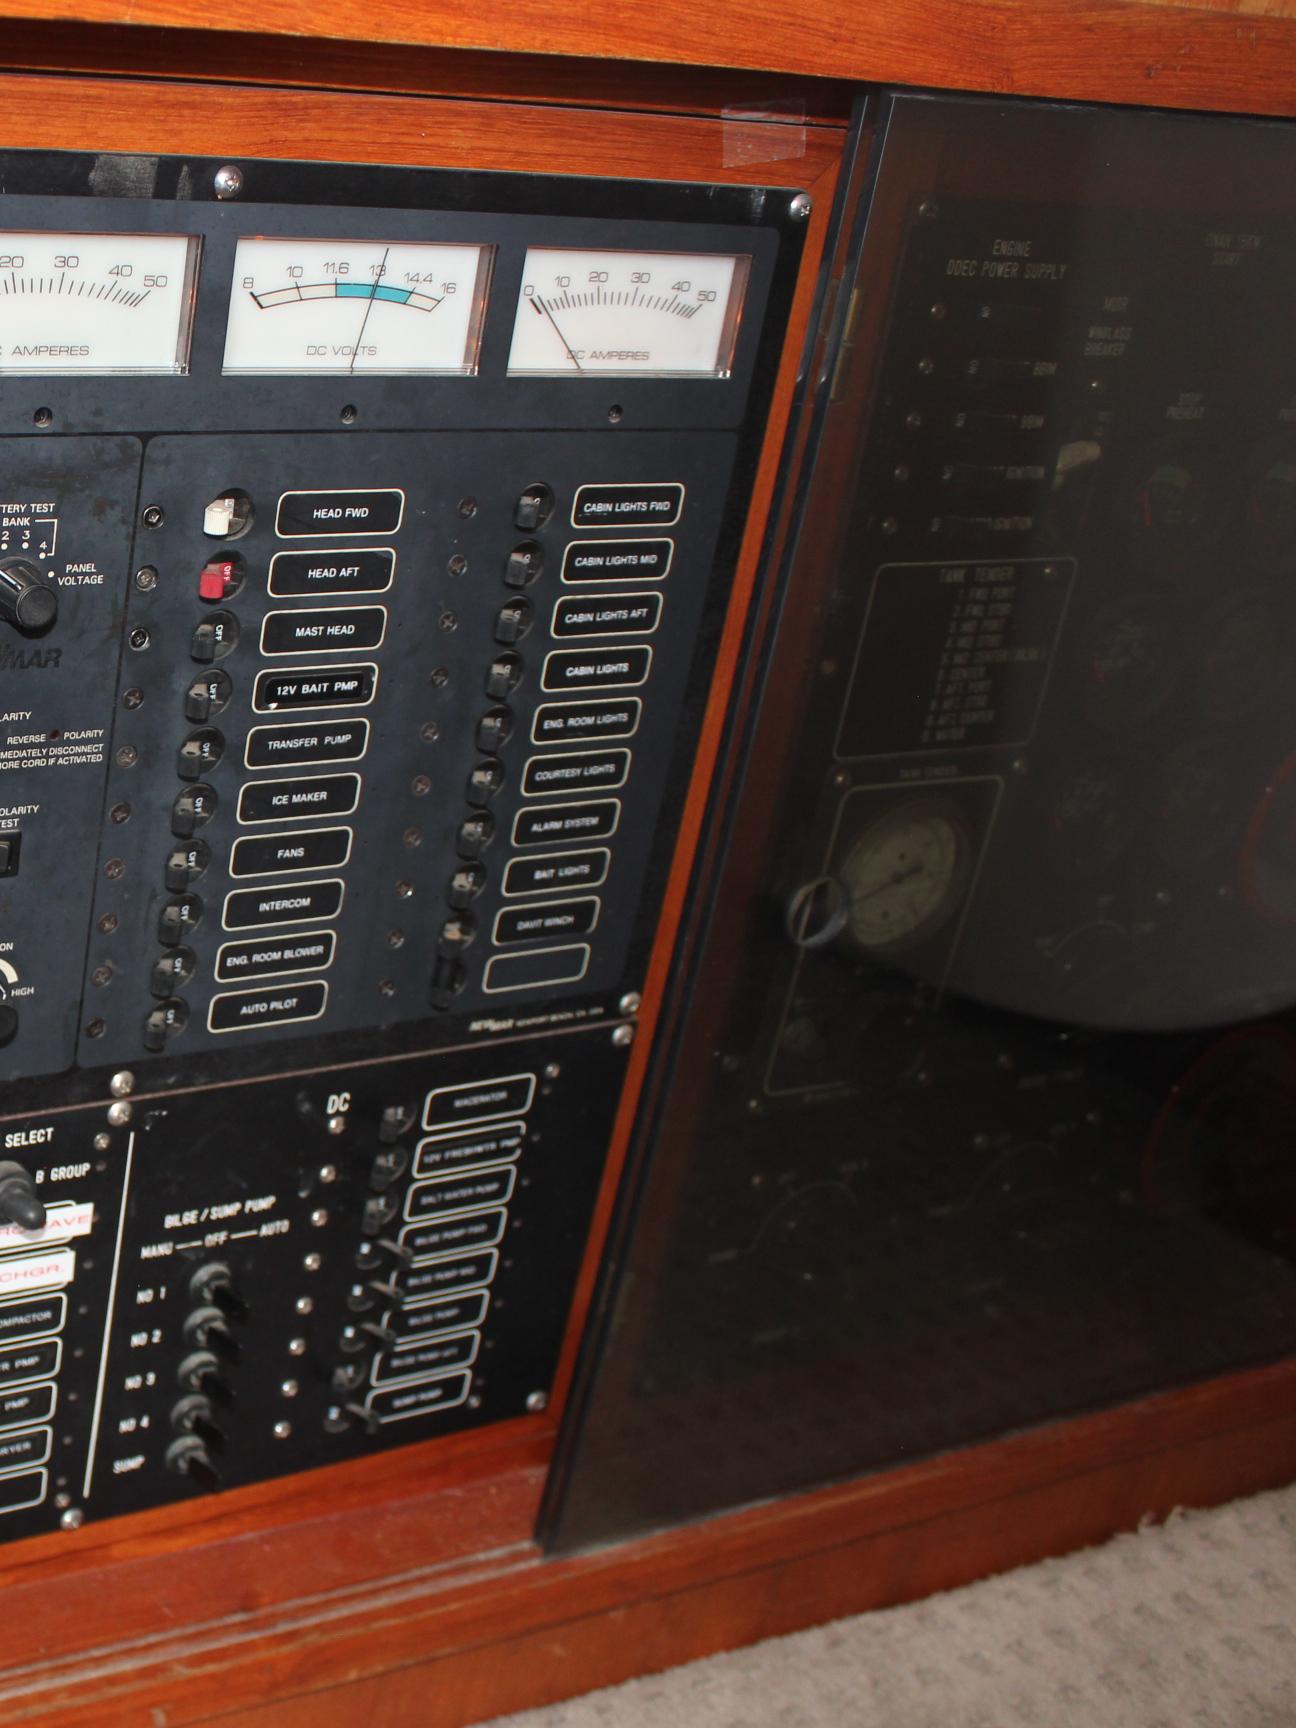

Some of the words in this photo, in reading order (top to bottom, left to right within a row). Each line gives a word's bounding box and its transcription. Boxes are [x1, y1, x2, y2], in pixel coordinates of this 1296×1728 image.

[0, 256, 24, 268] 20
[54, 256, 79, 268] 30
[109, 265, 132, 277] 40
[286, 266, 303, 278] 10
[323, 263, 349, 274] 11.6
[369, 265, 386, 276] 13
[144, 275, 167, 287] 50
[243, 277, 254, 289] 8
[404, 272, 433, 284] 14.4
[554, 277, 570, 288] 10
[588, 271, 608, 283] 20
[630, 272, 651, 284] 30
[441, 282, 457, 294] 16
[524, 285, 535, 297] 0
[671, 281, 691, 293] 40
[697, 291, 716, 302] 50
[12, 345, 90, 357] AMPERES
[306, 345, 327, 356] DC
[333, 345, 377, 356] VOLTS
[567, 350, 585, 361] DC
[590, 350, 650, 361] AMPERES
[30, 502, 55, 513] TEST
[313, 508, 342, 519] HEAD
[345, 507, 369, 518] FWD
[583, 502, 612, 513] CABIN
[615, 501, 648, 512] LIGHTS
[649, 501, 671, 511] FWD
[2, 517, 30, 527] BANK
[2, 531, 10, 540] 2
[22, 530, 30, 540] 3
[39, 541, 47, 550] 4
[574, 556, 603, 567] CABIN
[605, 555, 638, 566] LIGHTS
[65, 563, 97, 573] PANEL
[308, 568, 336, 579] HEAD
[339, 567, 360, 577] AFT
[57, 575, 104, 586] VOLTAGE
[564, 612, 594, 624] CABIN
[595, 610, 629, 621] LIGHTS
[630, 608, 648, 618] AFT
[295, 626, 324, 637] MAST
[327, 624, 355, 635] HEAD
[565, 665, 595, 677] CABIN
[596, 662, 629, 674] LIGHTS
[276, 685, 297, 696] 12V
[301, 683, 329, 694] BAIT
[334, 681, 358, 691] PMP
[7, 734, 46, 745] REVERSE
[64, 729, 104, 740] POLARITY
[268, 737, 318, 750] TRANSFER
[324, 734, 352, 745] PUMP
[49, 743, 104, 755] DISCONNECT
[21, 758, 46, 768] CORD
[48, 757, 56, 766] IF
[57, 754, 103, 766] ACTIVATED
[272, 795, 289, 805] ICE
[292, 791, 327, 803] MAKER
[277, 847, 304, 859] FANS
[259, 897, 311, 912] INTERCOM
[252, 952, 281, 963] ROOM
[11, 987, 35, 997] HIGH
[240, 1004, 268, 1015] AUTO
[327, 1092, 351, 1115] DC
[5, 1127, 54, 1148] SELECT
[35, 1169, 45, 1184] B
[50, 1163, 91, 1182] GROUP
[259, 1218, 290, 1237] AUTO
